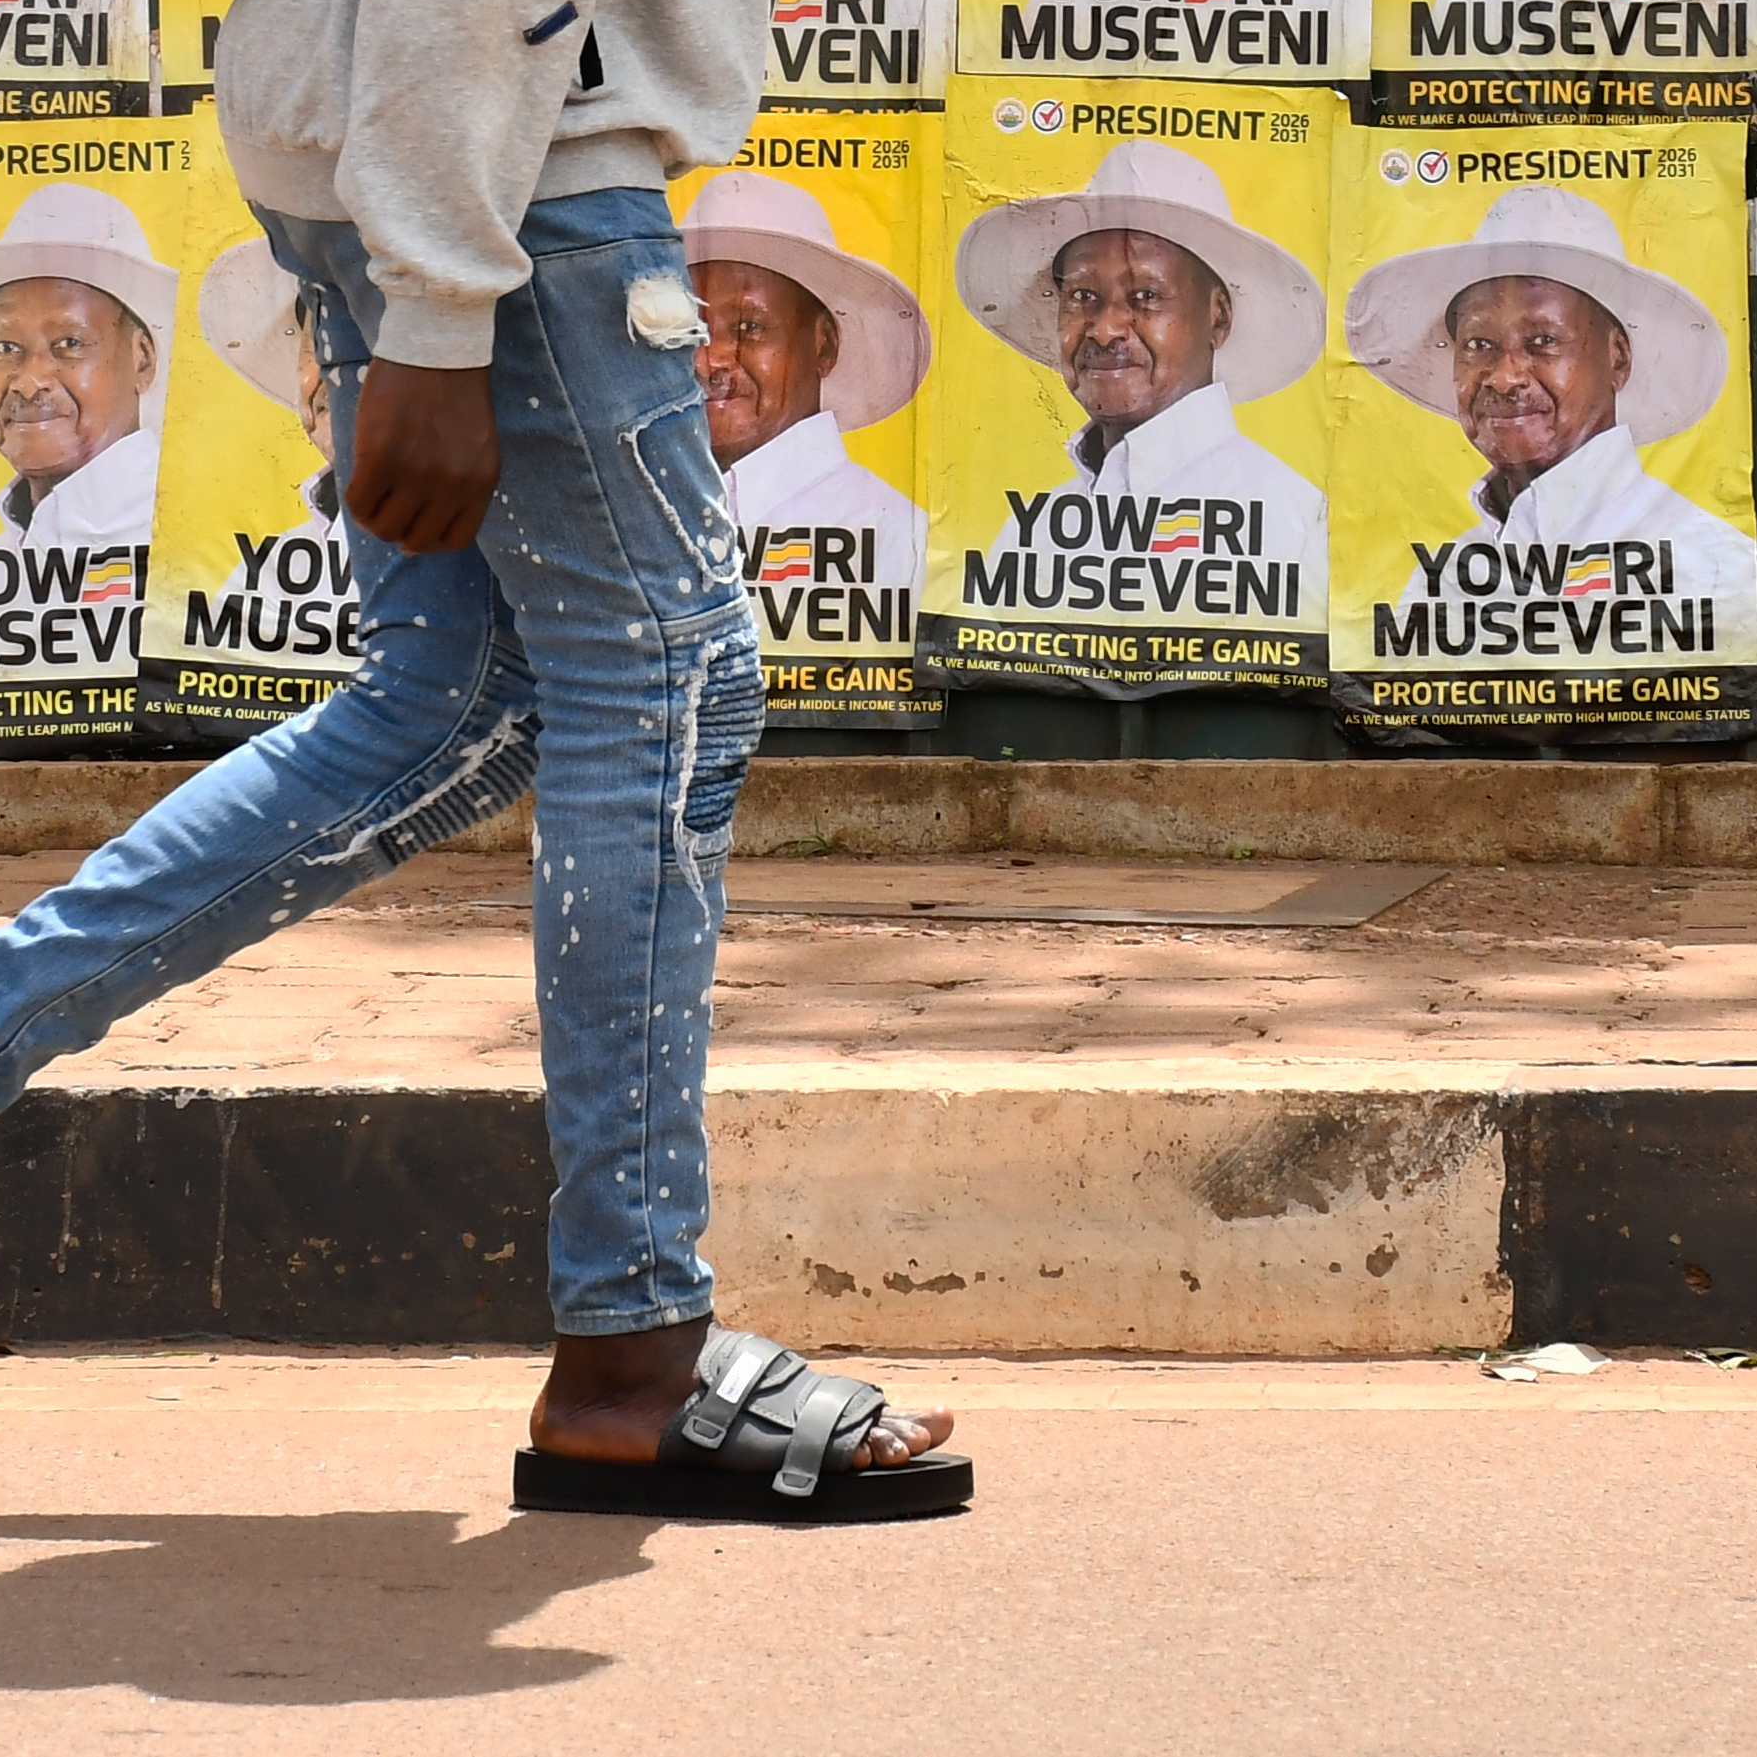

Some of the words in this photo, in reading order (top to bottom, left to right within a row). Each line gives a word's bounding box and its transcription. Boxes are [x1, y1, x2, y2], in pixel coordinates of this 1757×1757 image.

[1002, 5, 1328, 64] MUSEVENI
[1411, 1, 1746, 57] MUSEVENI
[1073, 105, 1265, 140] PRESIDENT
[1458, 149, 1652, 183] PRESIDENT
[1657, 164, 1694, 177] 2031
[1658, 148, 1696, 162] 2026
[964, 551, 1298, 616] MUSEVENI
[1374, 598, 1713, 656] MUSEVENI
[956, 628, 1137, 661] PROTECTING
[1147, 638, 1203, 662] THE
[1213, 639, 1300, 665] GAINS
